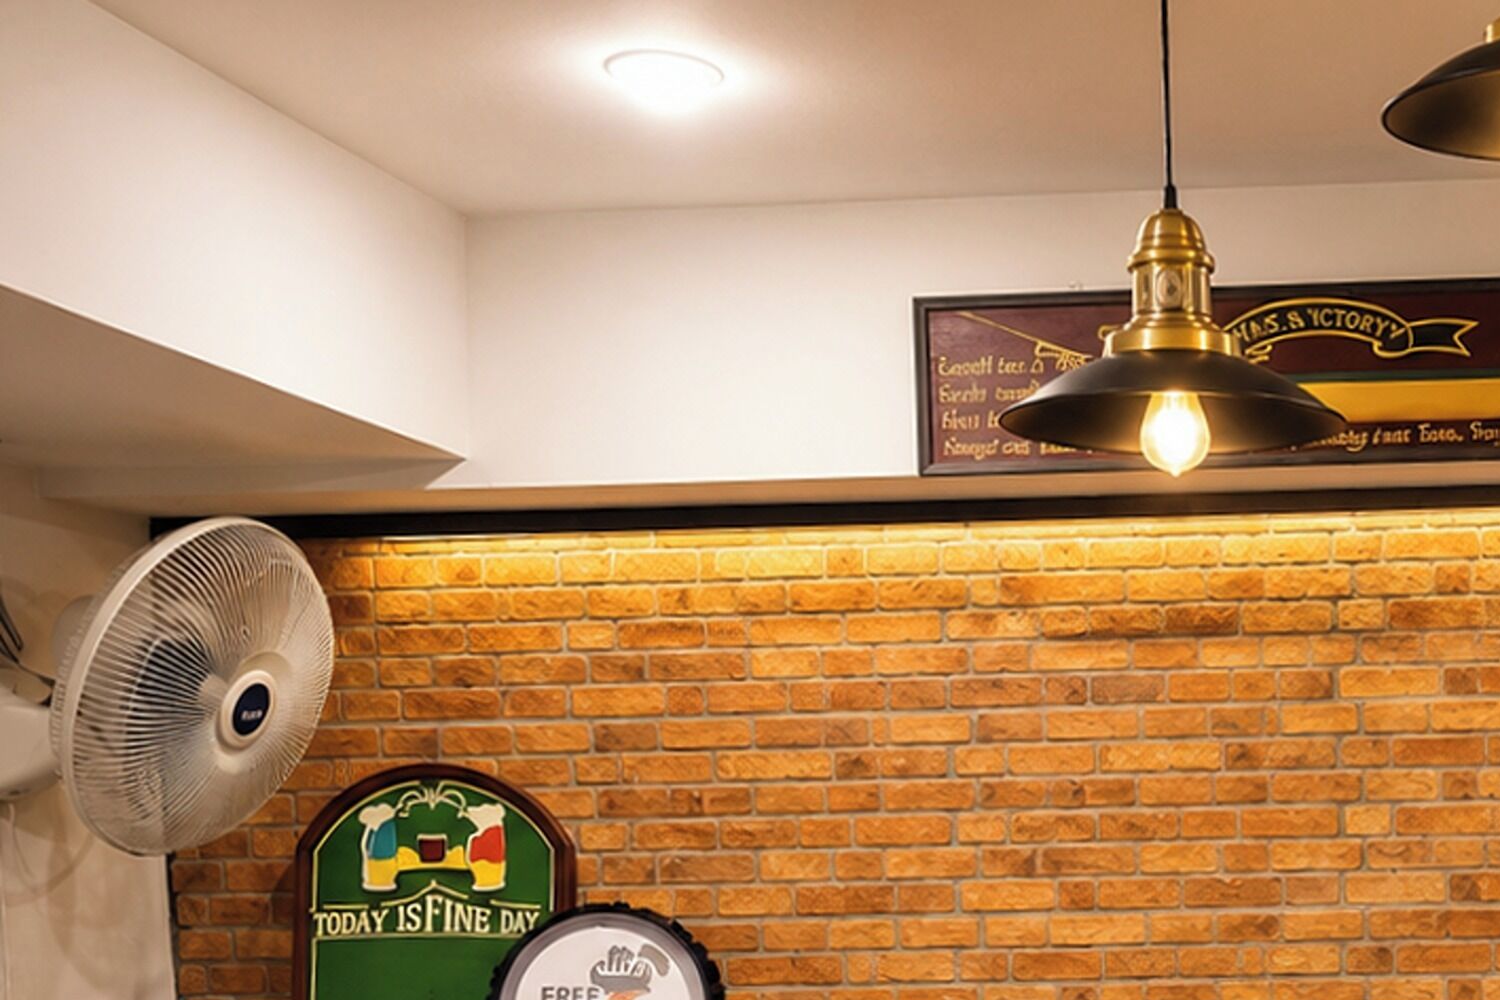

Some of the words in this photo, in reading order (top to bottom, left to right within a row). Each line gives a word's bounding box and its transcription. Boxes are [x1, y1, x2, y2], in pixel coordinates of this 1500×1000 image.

[313, 909, 390, 938] TODAY
[397, 903, 422, 932] IS
[424, 894, 492, 933] FINE
[500, 911, 540, 935] DAY
